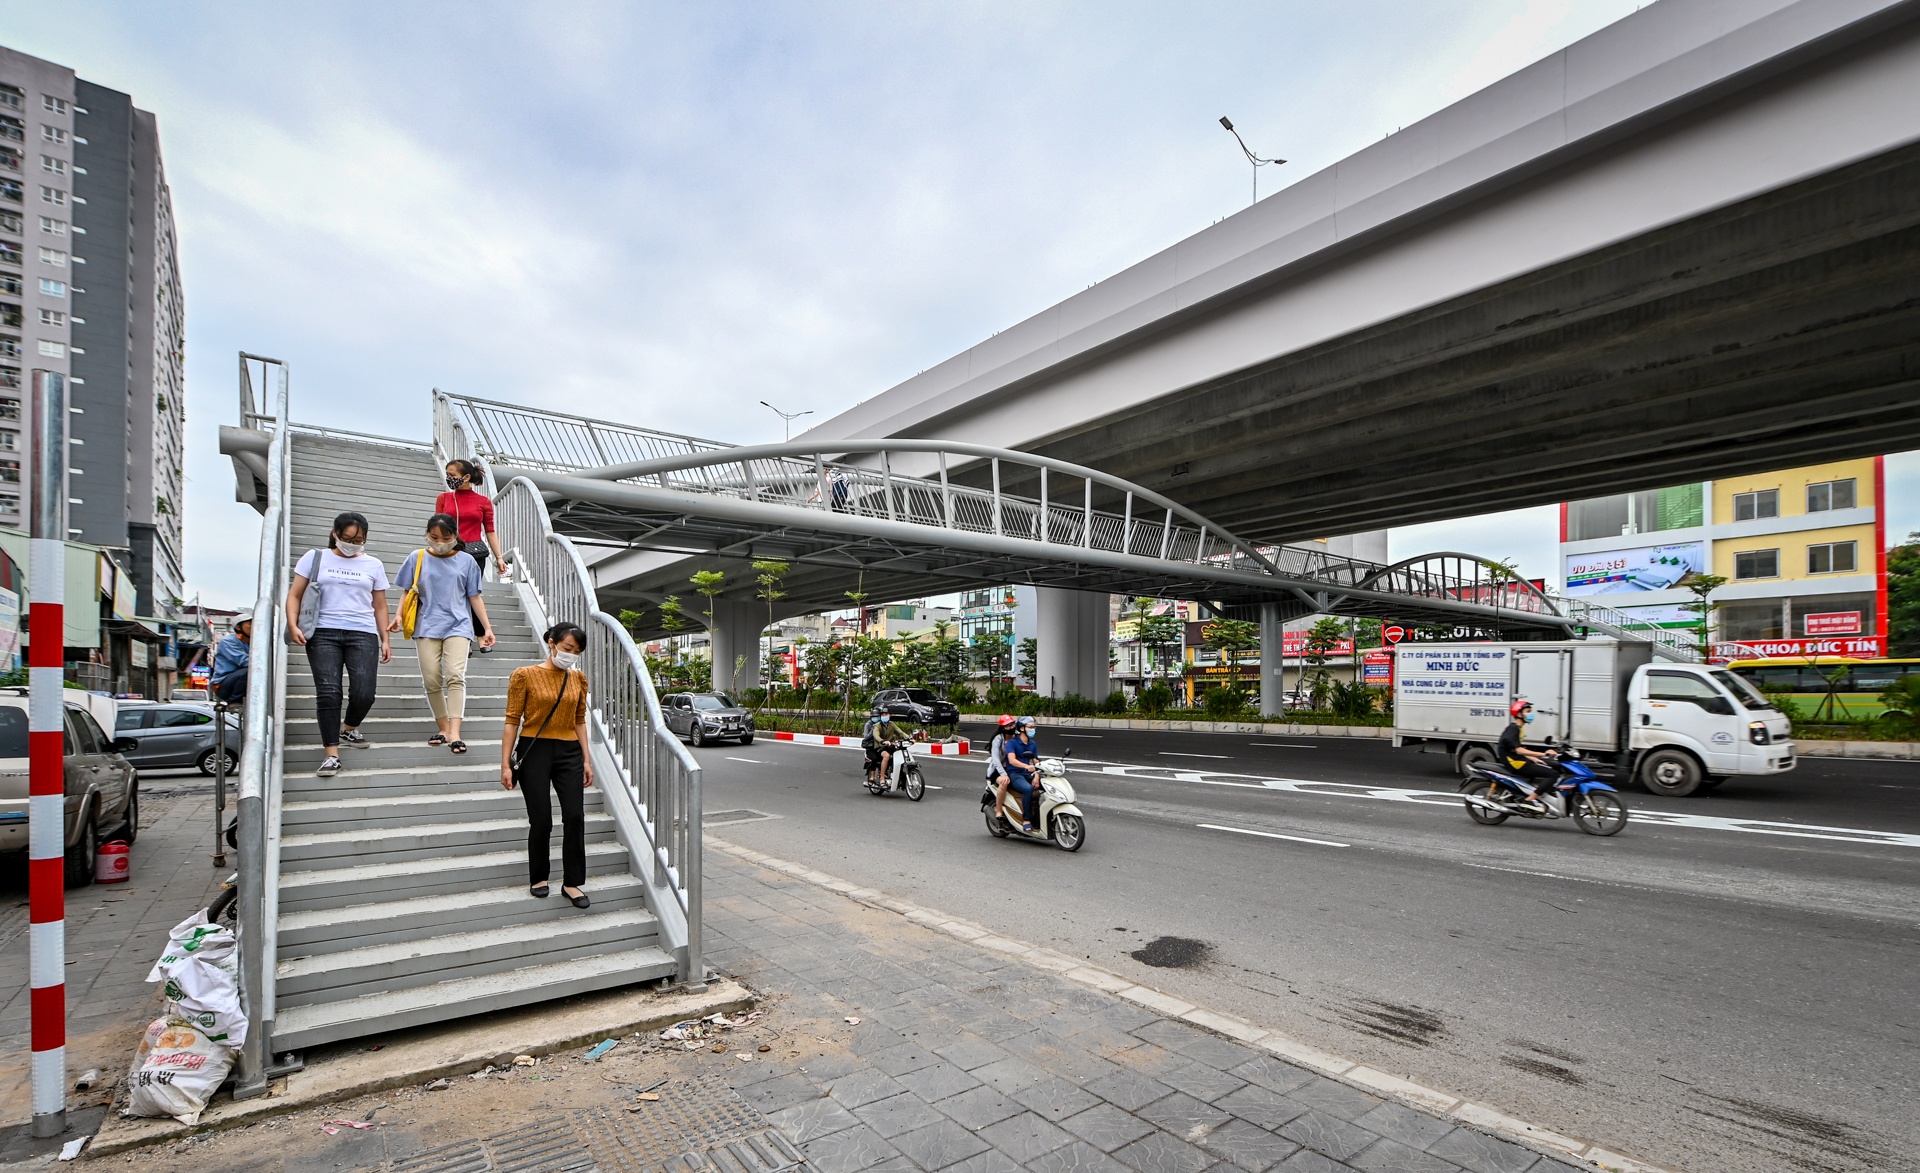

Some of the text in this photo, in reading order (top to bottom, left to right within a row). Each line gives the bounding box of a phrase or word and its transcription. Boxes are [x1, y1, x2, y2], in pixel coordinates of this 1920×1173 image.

[1755, 643, 1800, 655] KHOA
[1805, 639, 1842, 654] ĐỨC
[1845, 637, 1877, 652] TÍN
[1426, 659, 1480, 671] MINH ĐỨC
[1402, 679, 1415, 687] NHÀ
[1434, 679, 1447, 687] CẤP
[1486, 682, 1505, 690] SẠCH
